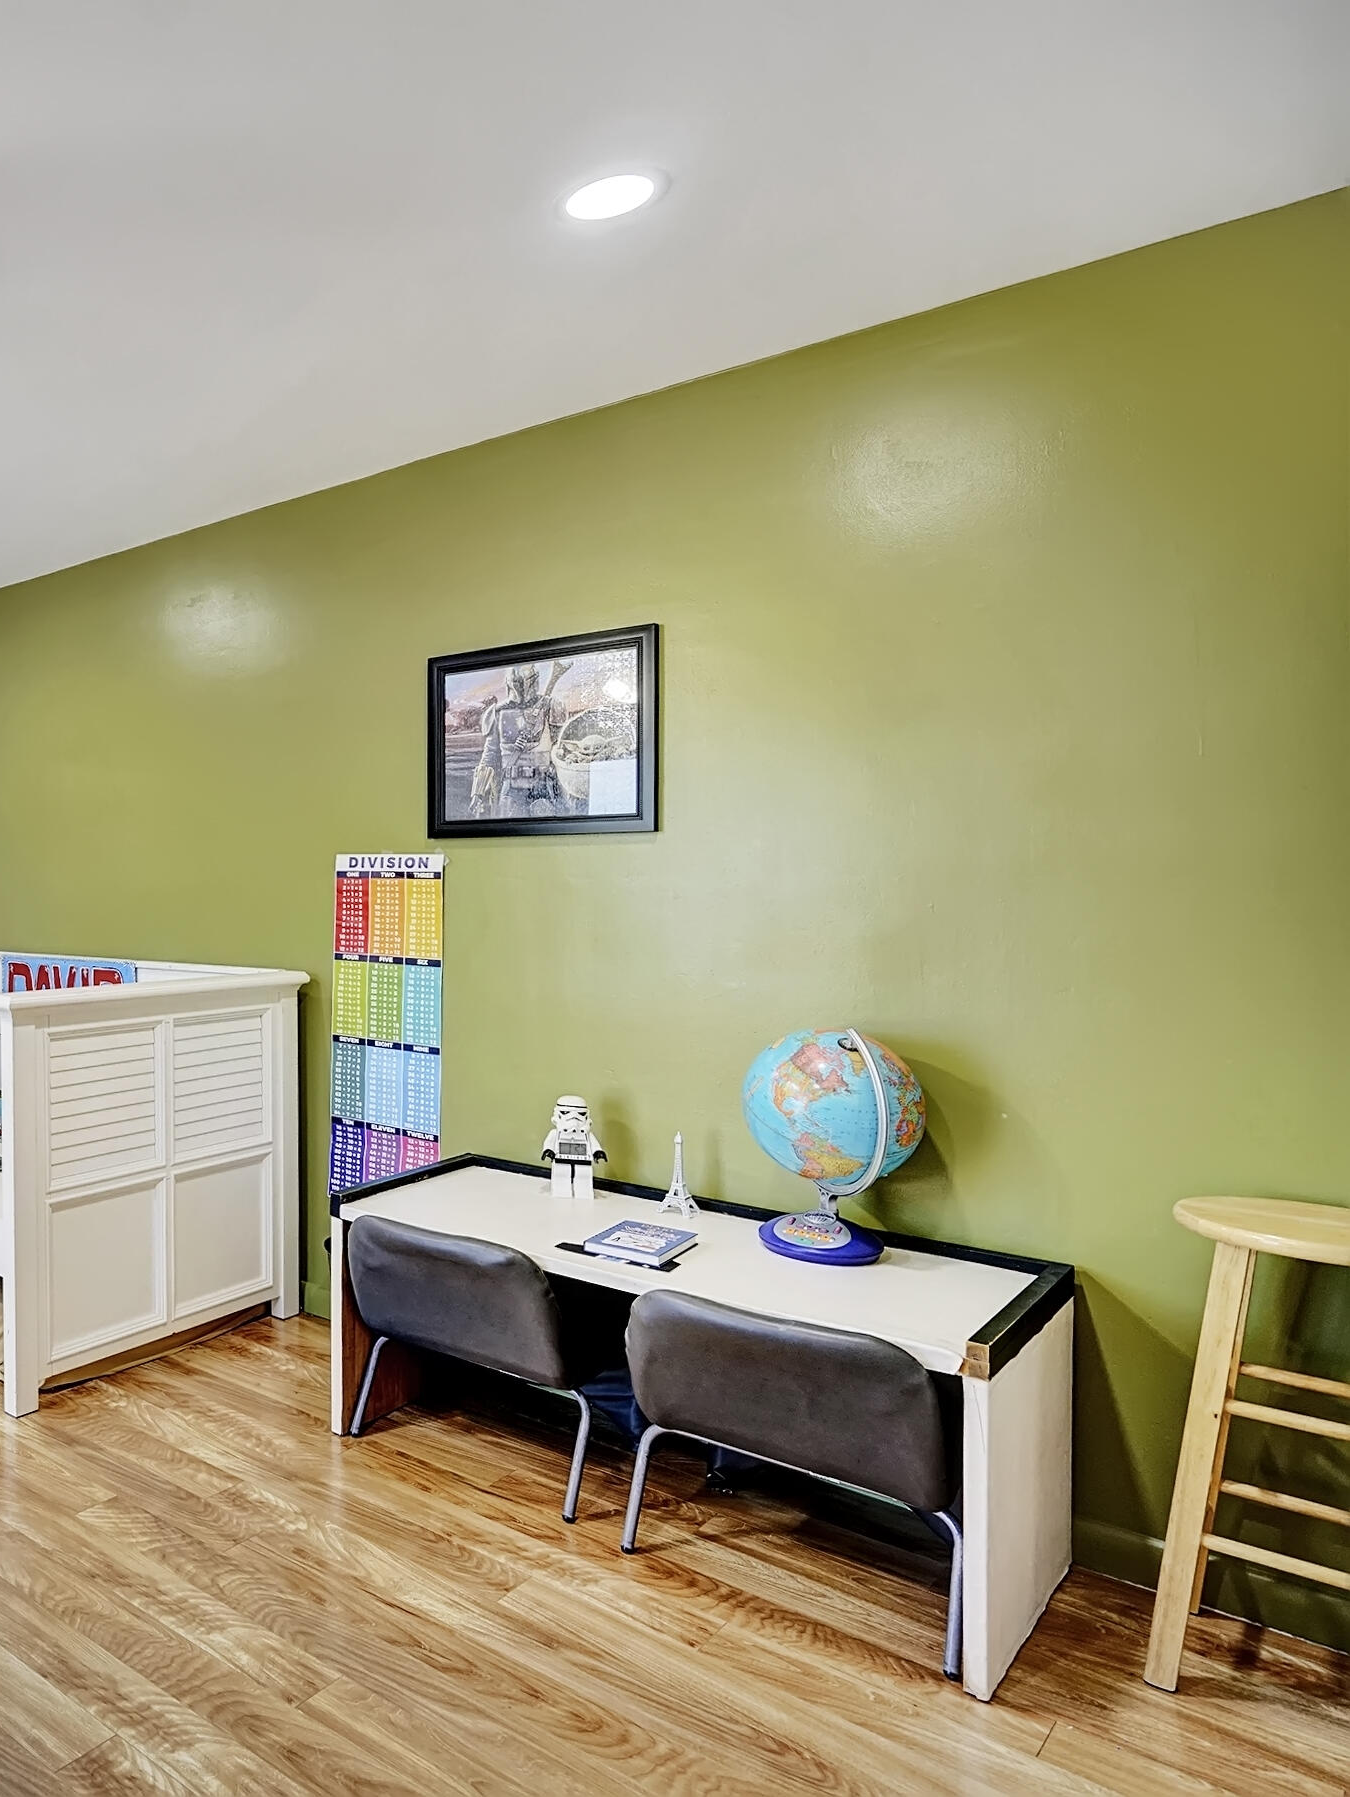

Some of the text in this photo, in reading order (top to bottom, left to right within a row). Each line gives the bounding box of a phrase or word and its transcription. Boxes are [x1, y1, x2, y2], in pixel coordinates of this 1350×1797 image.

[349, 856, 430, 869] DIVISION
[339, 1036, 360, 1044] SEVEN
[342, 1118, 355, 1126] TEN
[371, 1124, 396, 1134] ELEVEN
[406, 1131, 435, 1141] TWELVE
